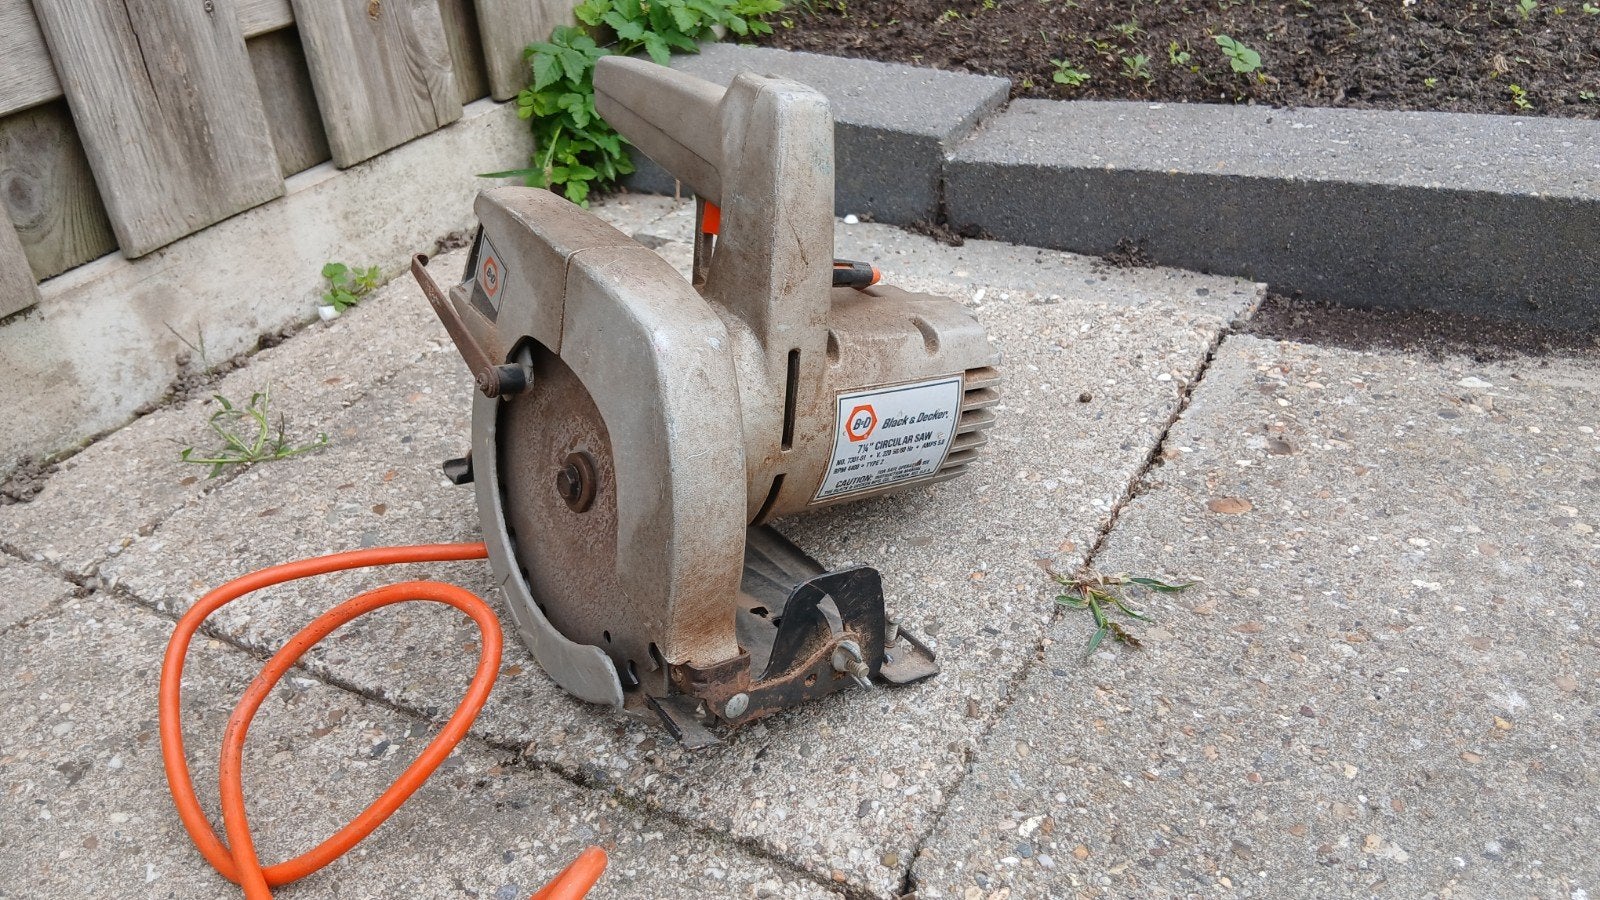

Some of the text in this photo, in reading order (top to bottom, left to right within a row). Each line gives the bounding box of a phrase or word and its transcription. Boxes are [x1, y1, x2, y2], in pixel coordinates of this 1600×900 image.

[881, 415, 908, 430] Black
[908, 416, 916, 424] &
[875, 435, 914, 451] CIRCULAR
[914, 431, 933, 443] SAW
[922, 440, 937, 449] AMPS
[866, 460, 879, 468] TYPE
